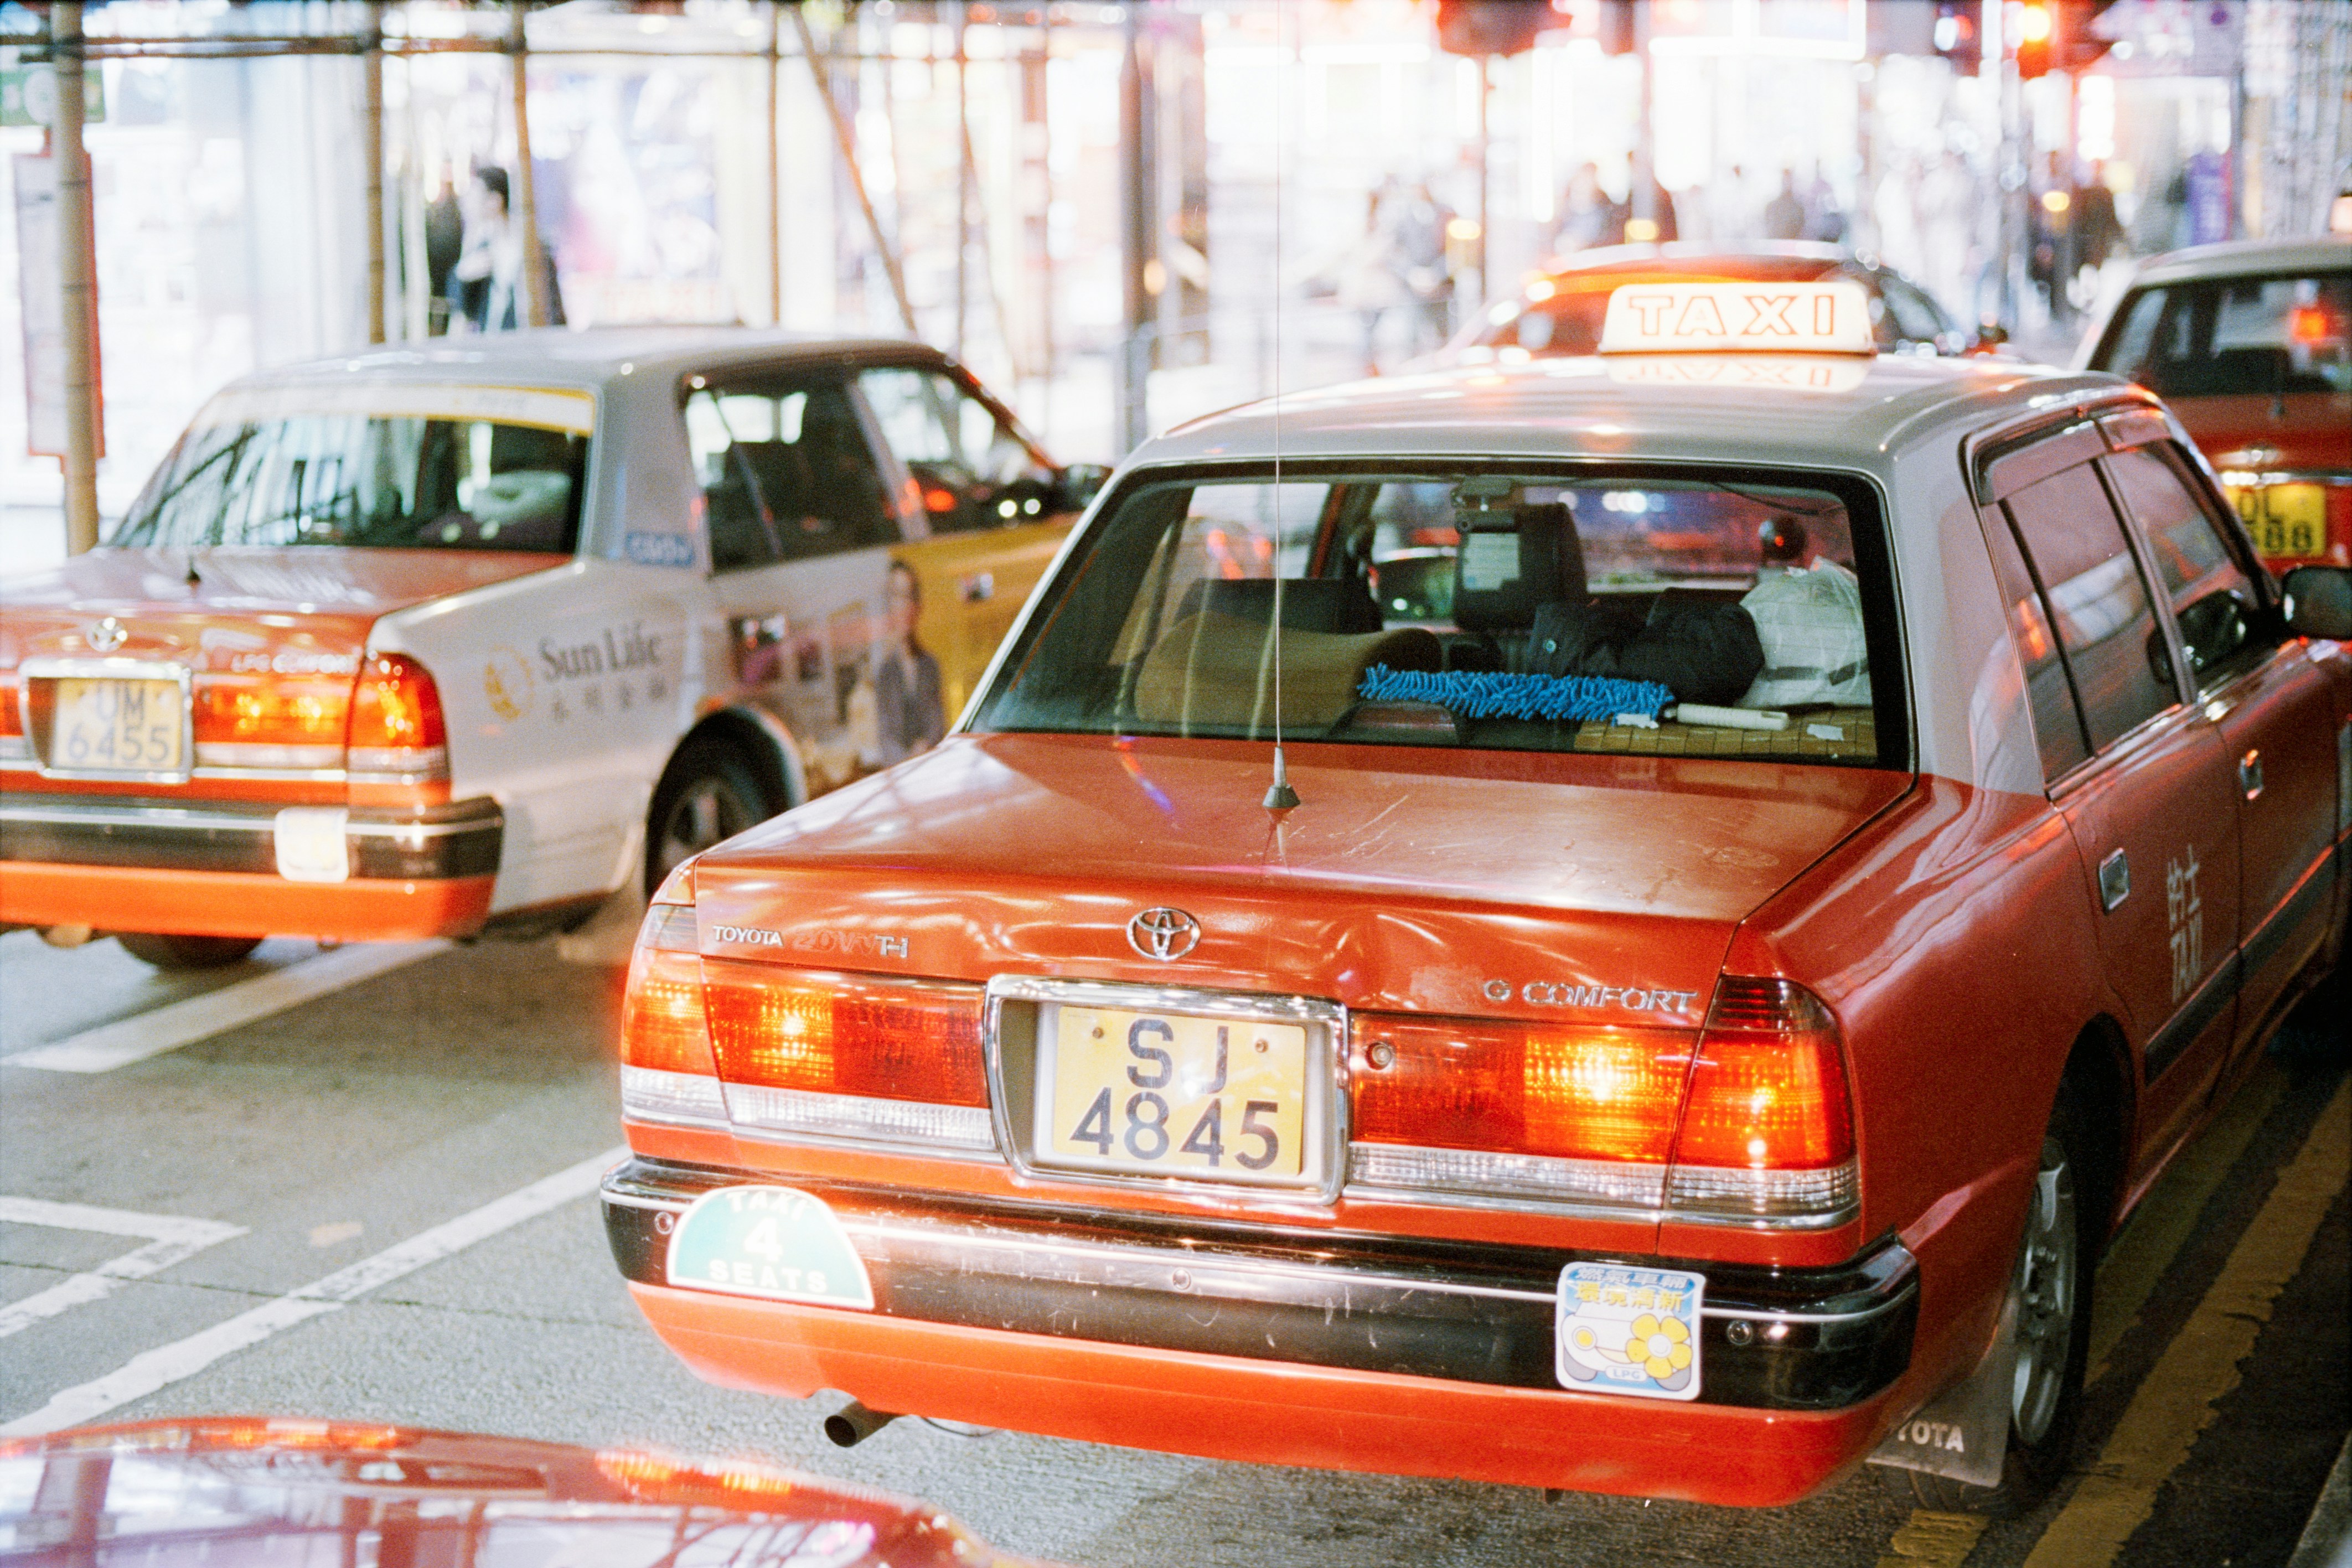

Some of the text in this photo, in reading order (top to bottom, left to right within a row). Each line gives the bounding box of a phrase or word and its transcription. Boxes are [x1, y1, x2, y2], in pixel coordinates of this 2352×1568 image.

[1628, 294, 1835, 336] TAXI
[538, 619, 663, 682] Sun Life
[68, 721, 169, 763] 6455
[713, 925, 784, 946] TOYOTA
[1483, 980, 1698, 1013] G COMFORT
[1127, 1018, 1228, 1094] SJ
[1069, 1086, 1279, 1171] 4845
[743, 1216, 783, 1262] 4
[709, 1259, 828, 1293] SEATS
[1613, 1368, 1641, 1380] LPG
